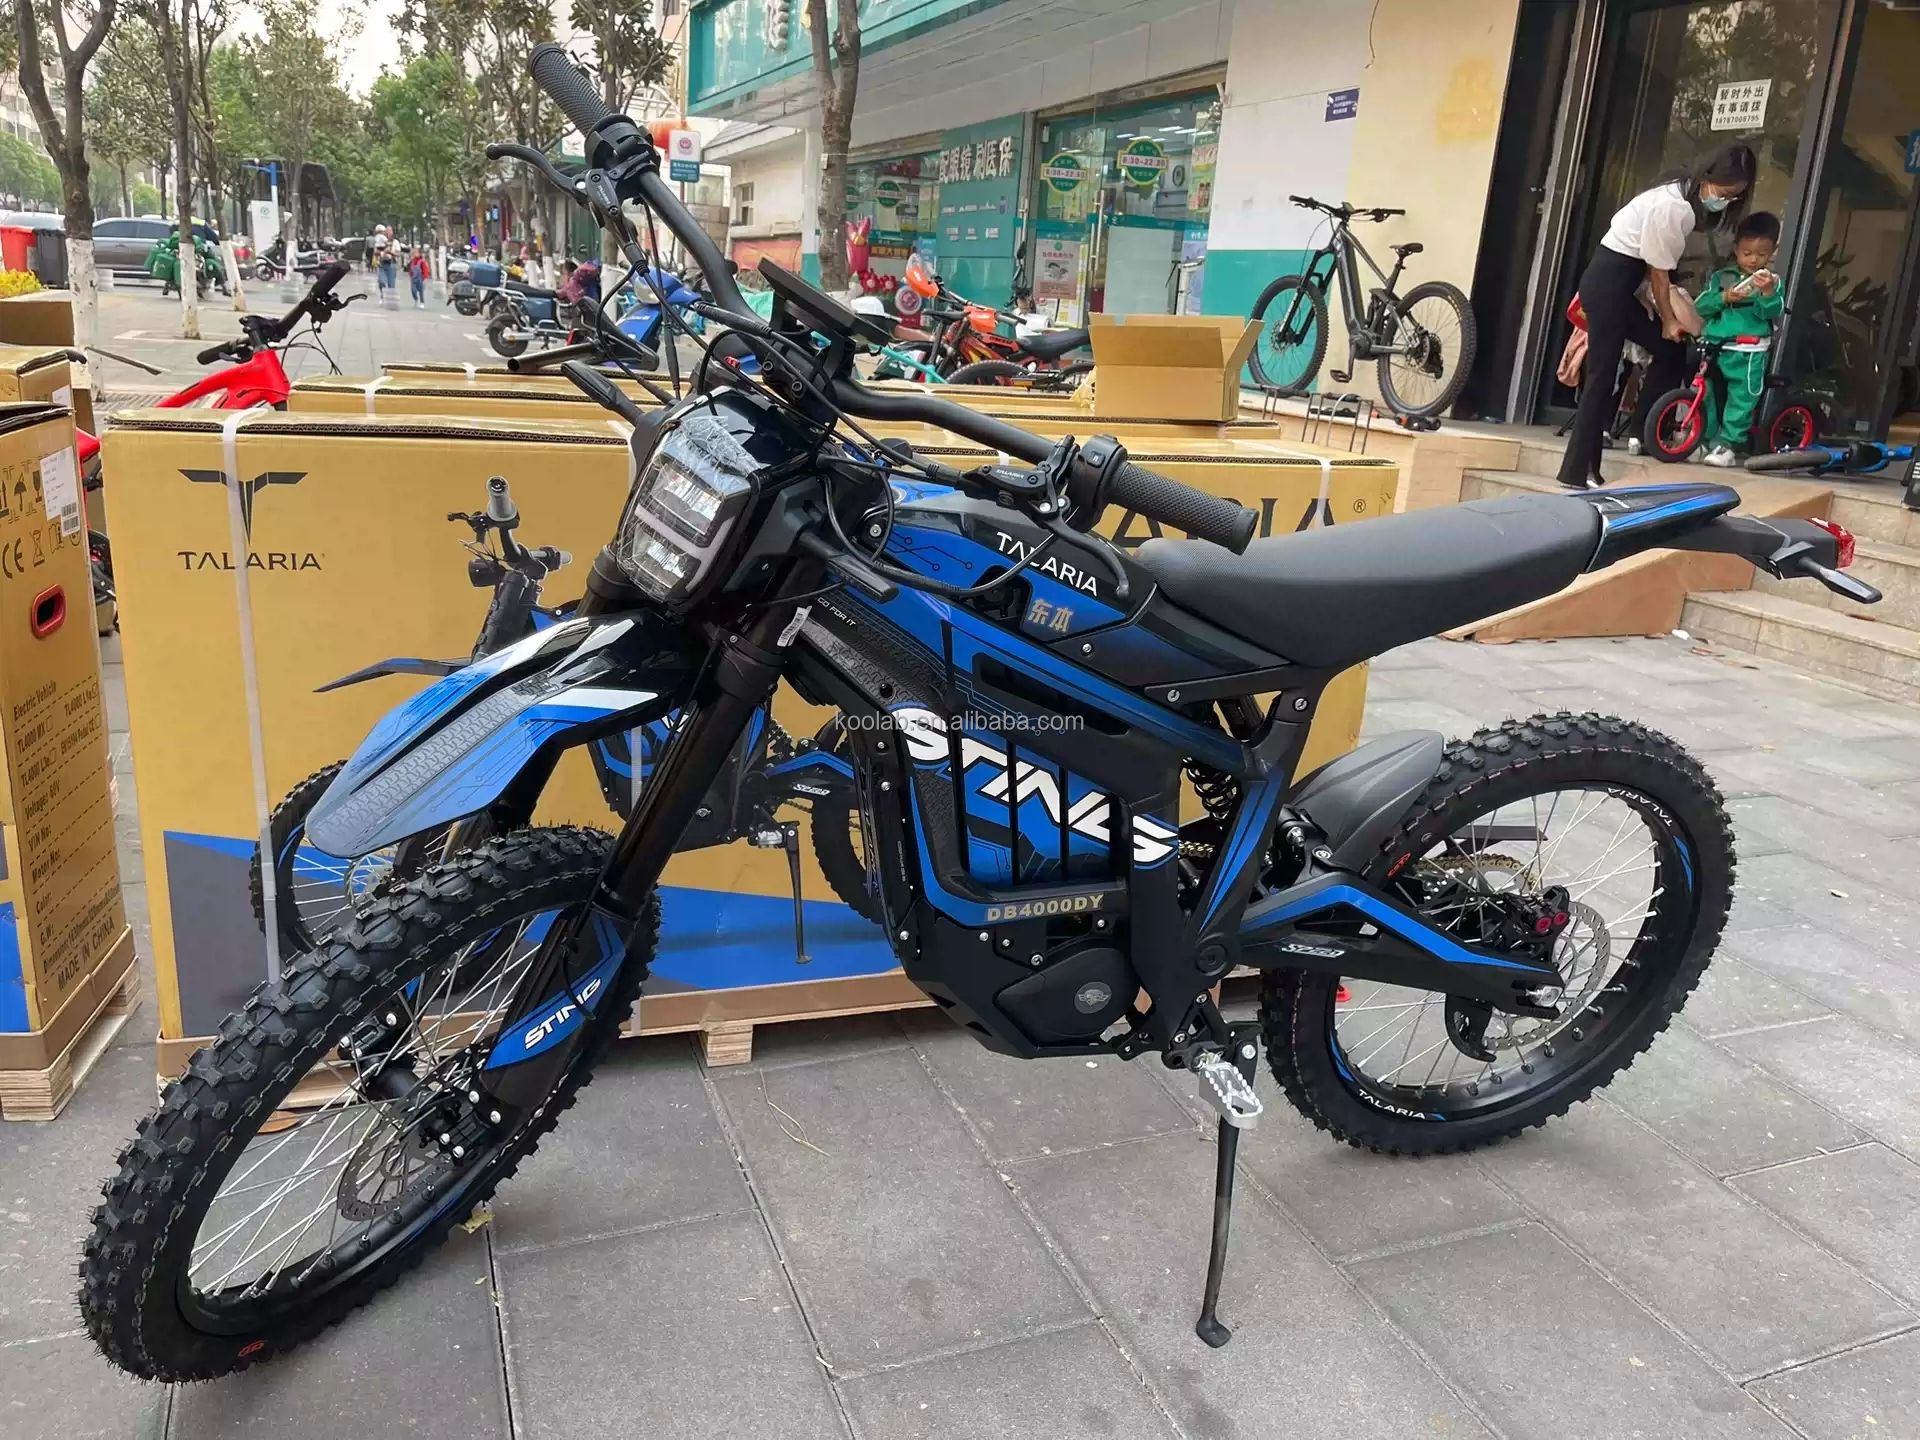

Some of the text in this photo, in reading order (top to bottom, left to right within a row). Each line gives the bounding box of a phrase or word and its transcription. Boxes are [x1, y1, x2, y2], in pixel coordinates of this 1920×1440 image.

[1717, 100, 1761, 115] 有事请拨
[1720, 86, 1764, 100] 暂时外出
[178, 551, 322, 571] TALARIA
[829, 606, 847, 621] FOR
[846, 618, 857, 627] IT
[1031, 598, 1074, 633] 东本
[14, 680, 57, 721] Electric Vehicle
[1608, 788, 1672, 826] TALARIA
[987, 894, 1104, 921] DB4000DY
[58, 955, 81, 991] MADE
[83, 947, 91, 964] IN
[92, 916, 115, 950] CHINA
[524, 979, 601, 1049] STING
[1359, 1088, 1426, 1120] TALARIA
